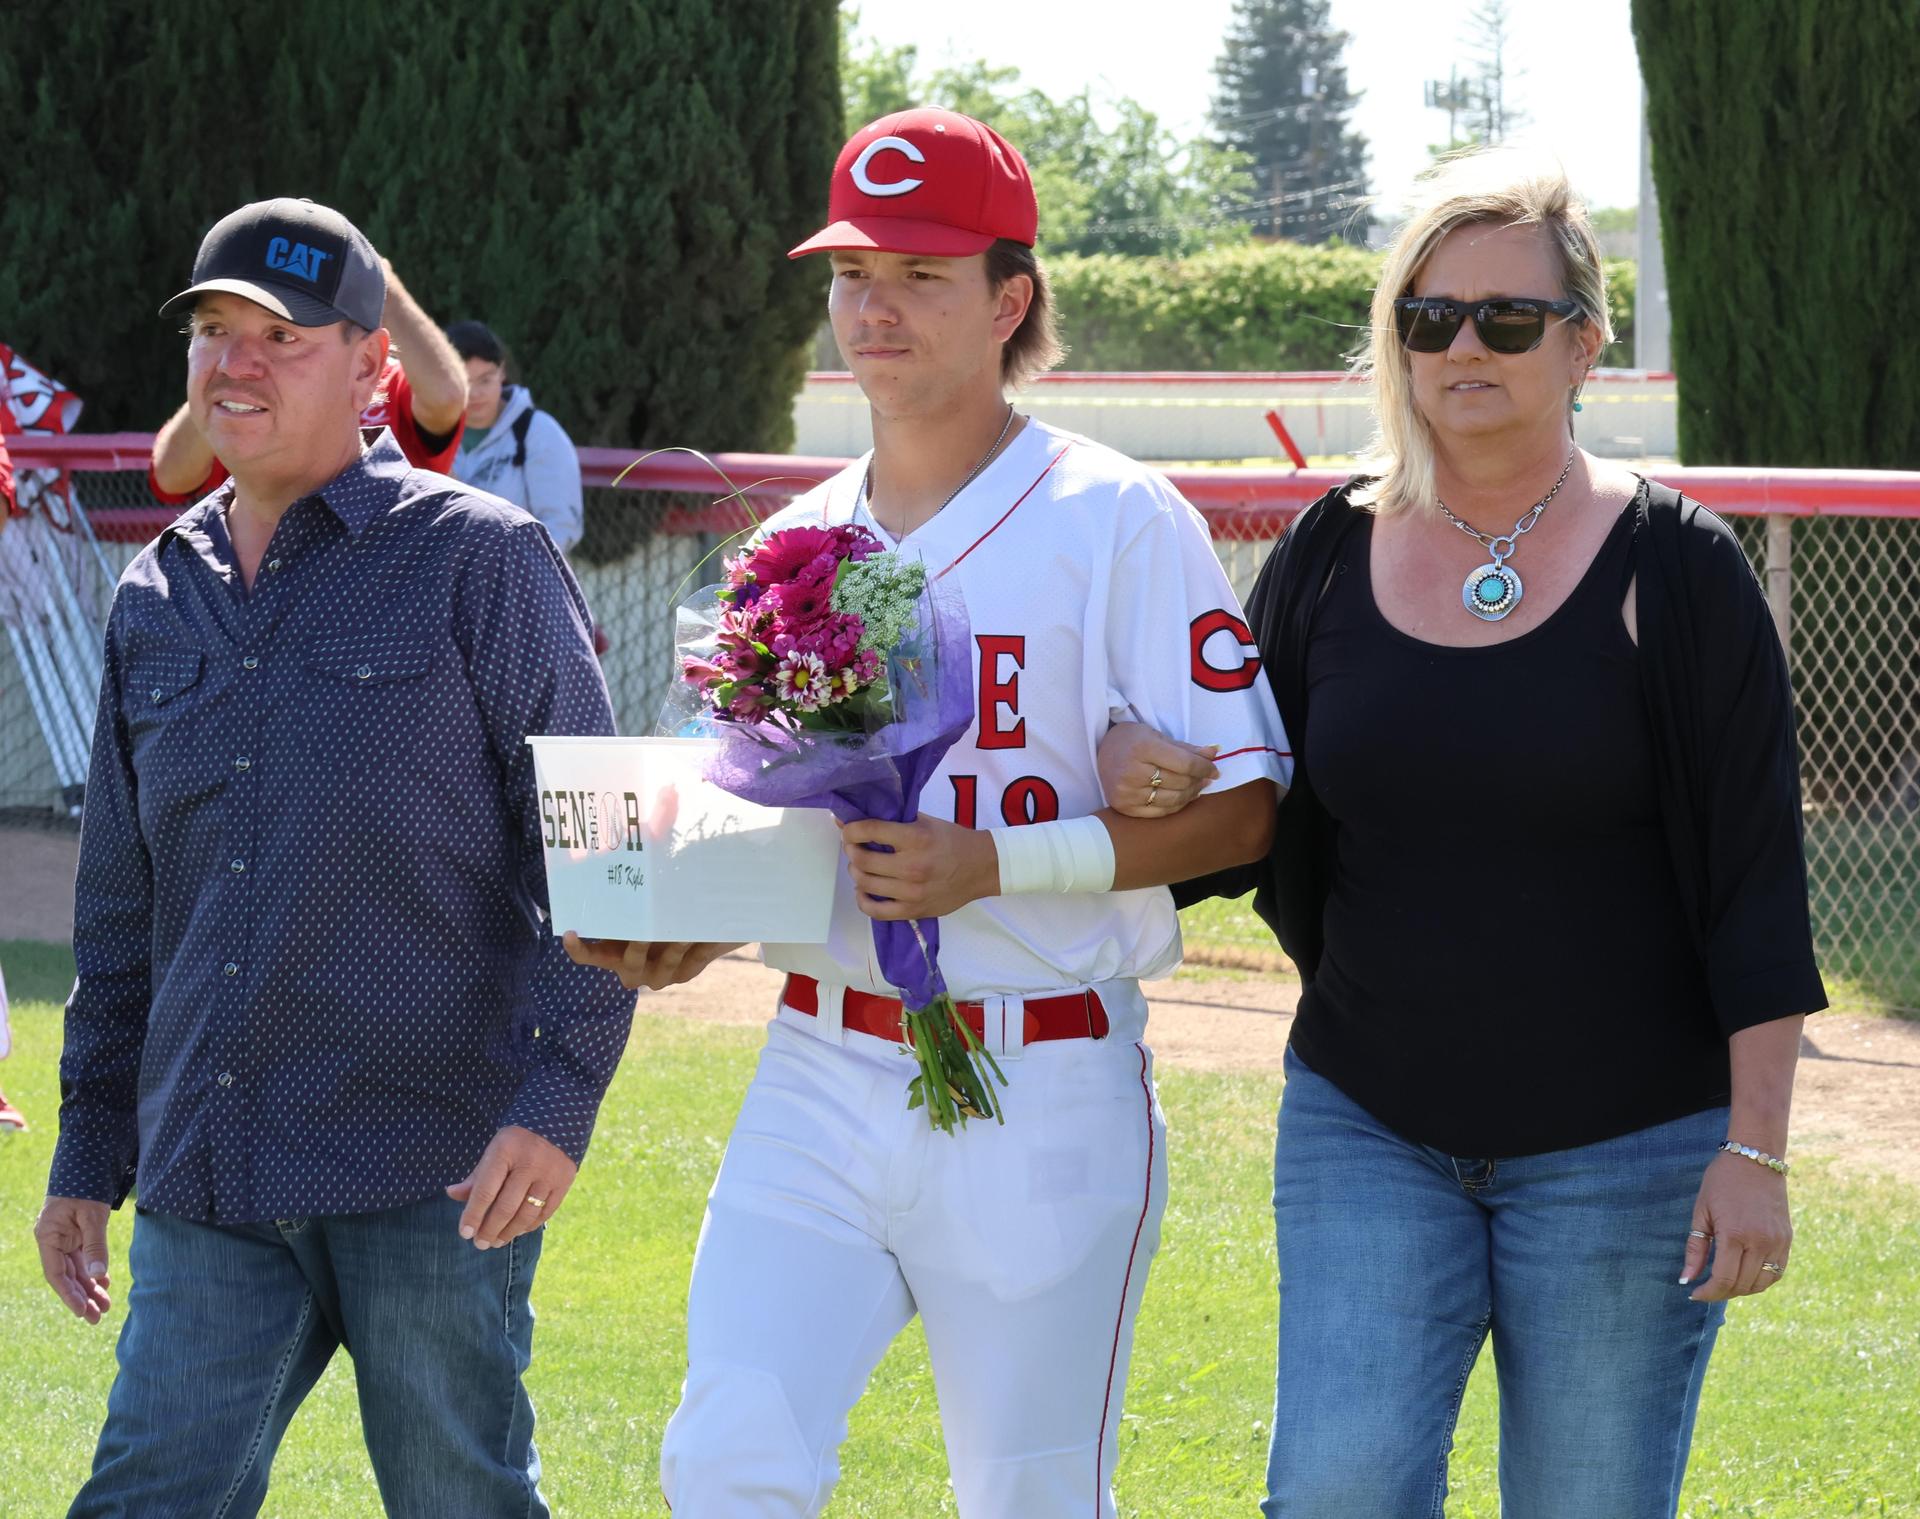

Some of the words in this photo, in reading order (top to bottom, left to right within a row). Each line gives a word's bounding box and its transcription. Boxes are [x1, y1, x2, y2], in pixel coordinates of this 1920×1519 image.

[849, 135, 926, 197] C
[265, 236, 327, 283] CAT
[1189, 608, 1262, 693] C
[624, 864, 644, 892] Kyle
